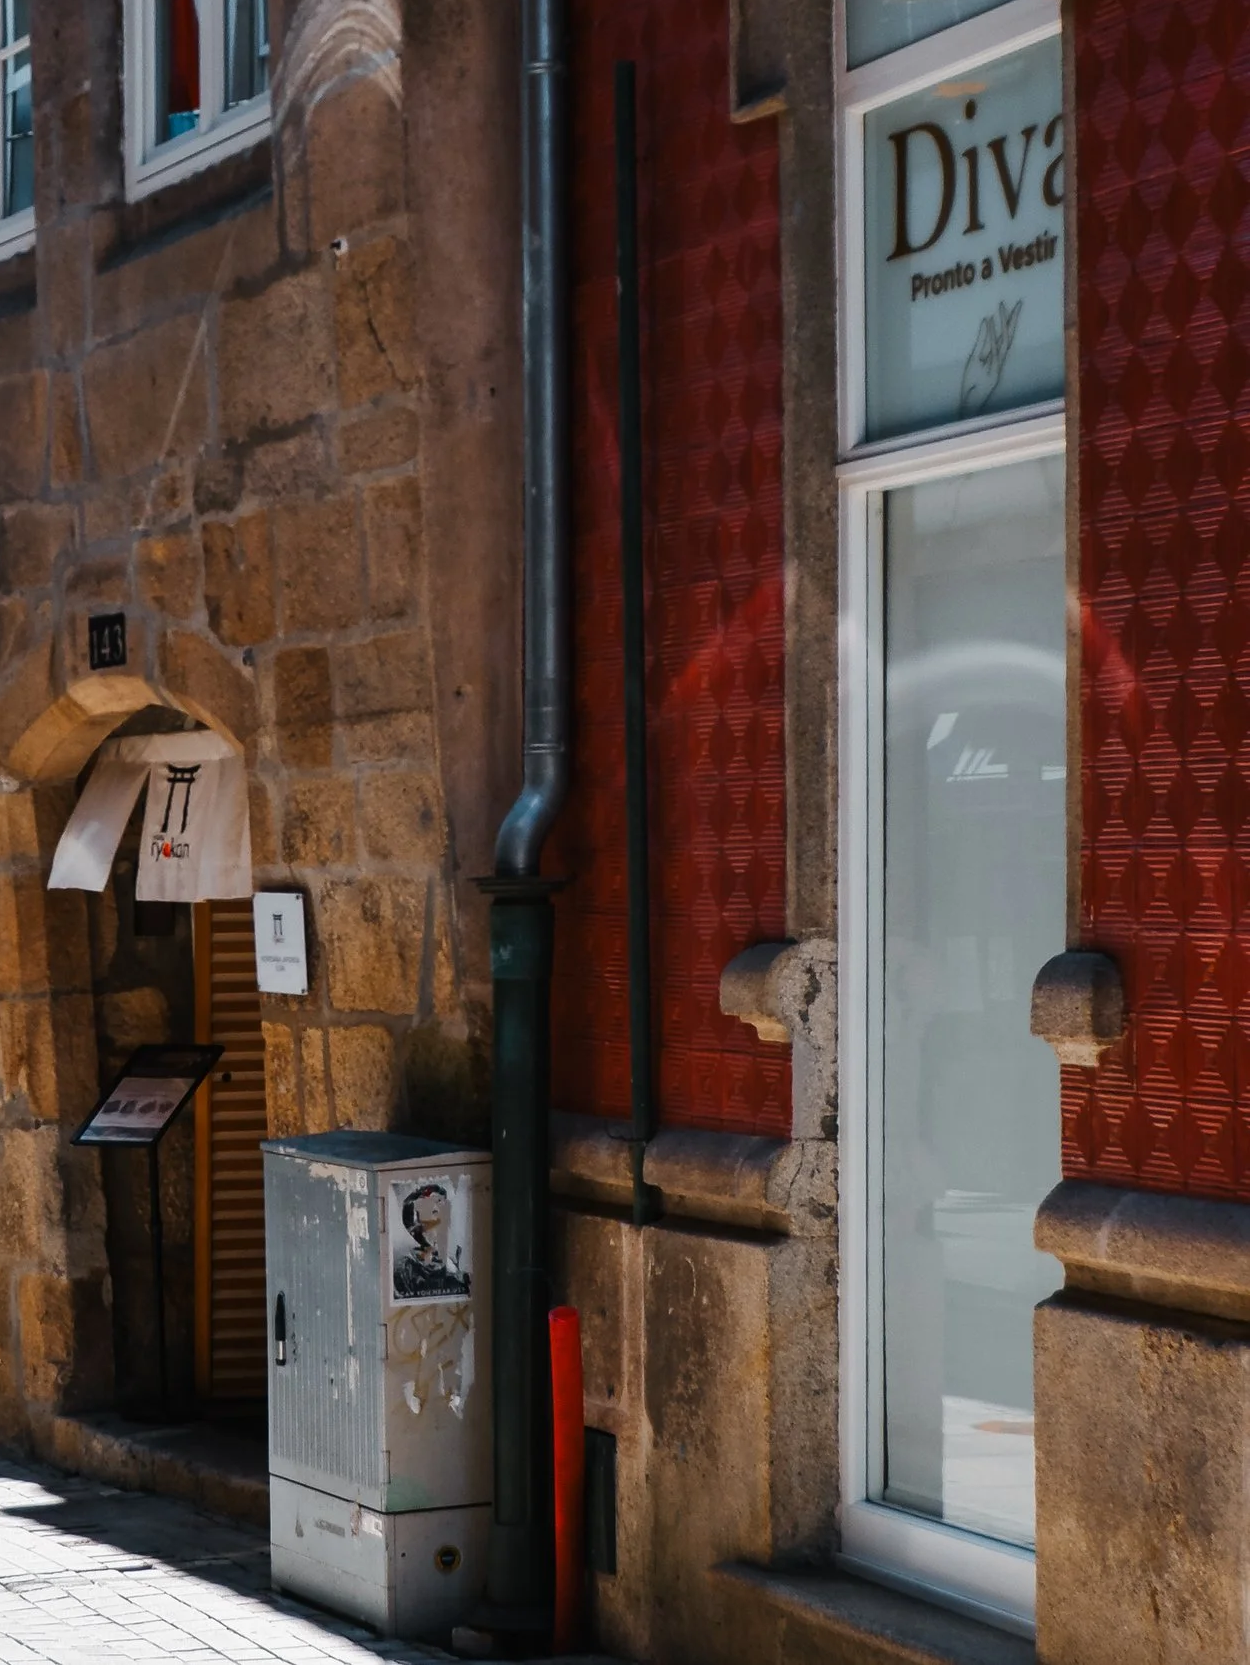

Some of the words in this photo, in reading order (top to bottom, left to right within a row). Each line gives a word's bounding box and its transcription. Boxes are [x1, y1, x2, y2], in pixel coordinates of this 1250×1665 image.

[910, 260, 976, 302] Pronto
[981, 256, 993, 280] a
[997, 229, 1059, 273] Vestir
[92, 623, 124, 665] 143
